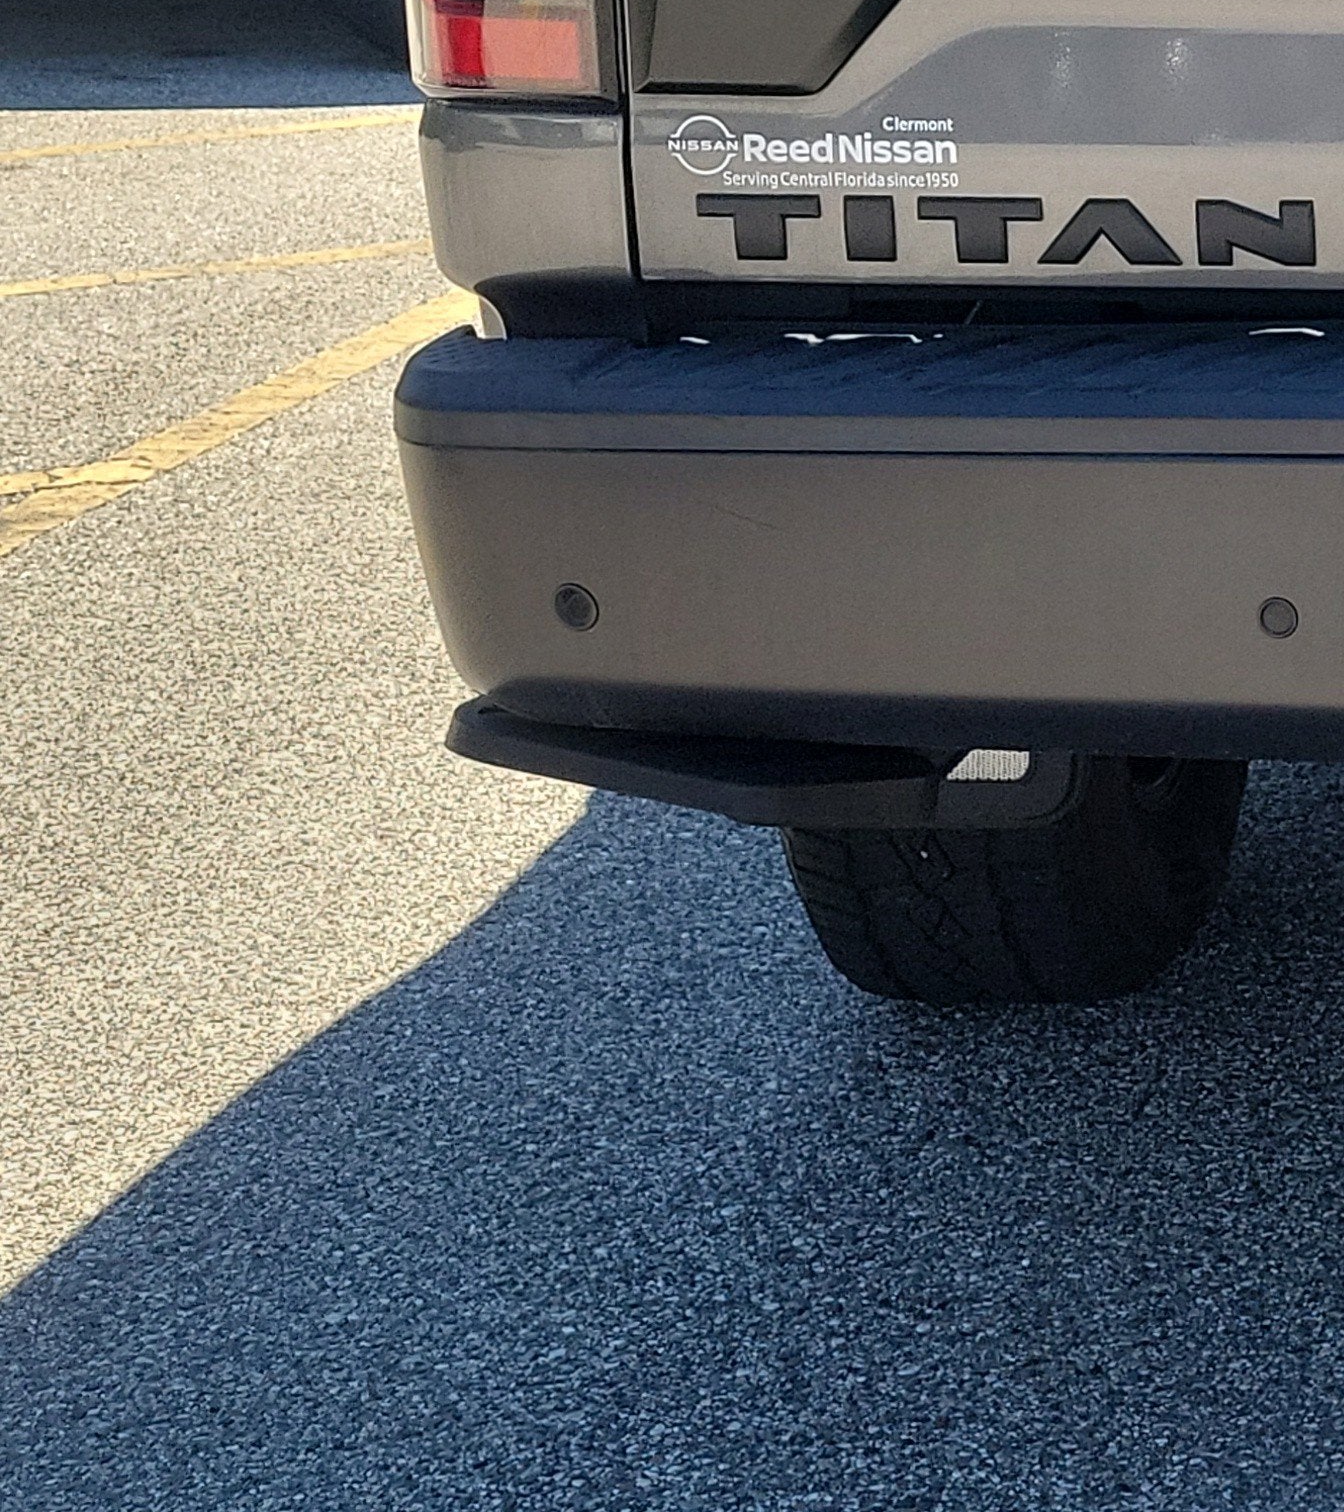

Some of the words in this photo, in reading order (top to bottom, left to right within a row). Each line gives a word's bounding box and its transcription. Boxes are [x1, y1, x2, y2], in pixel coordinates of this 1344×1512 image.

[882, 115, 954, 132] Clermont
[667, 139, 739, 152] NISSAN
[723, 171, 778, 189] Serving
[780, 172, 833, 188] Central
[835, 172, 885, 188] Florida
[887, 173, 925, 188] since
[926, 172, 959, 188] 1950
[696, 194, 1316, 266] TITAN
